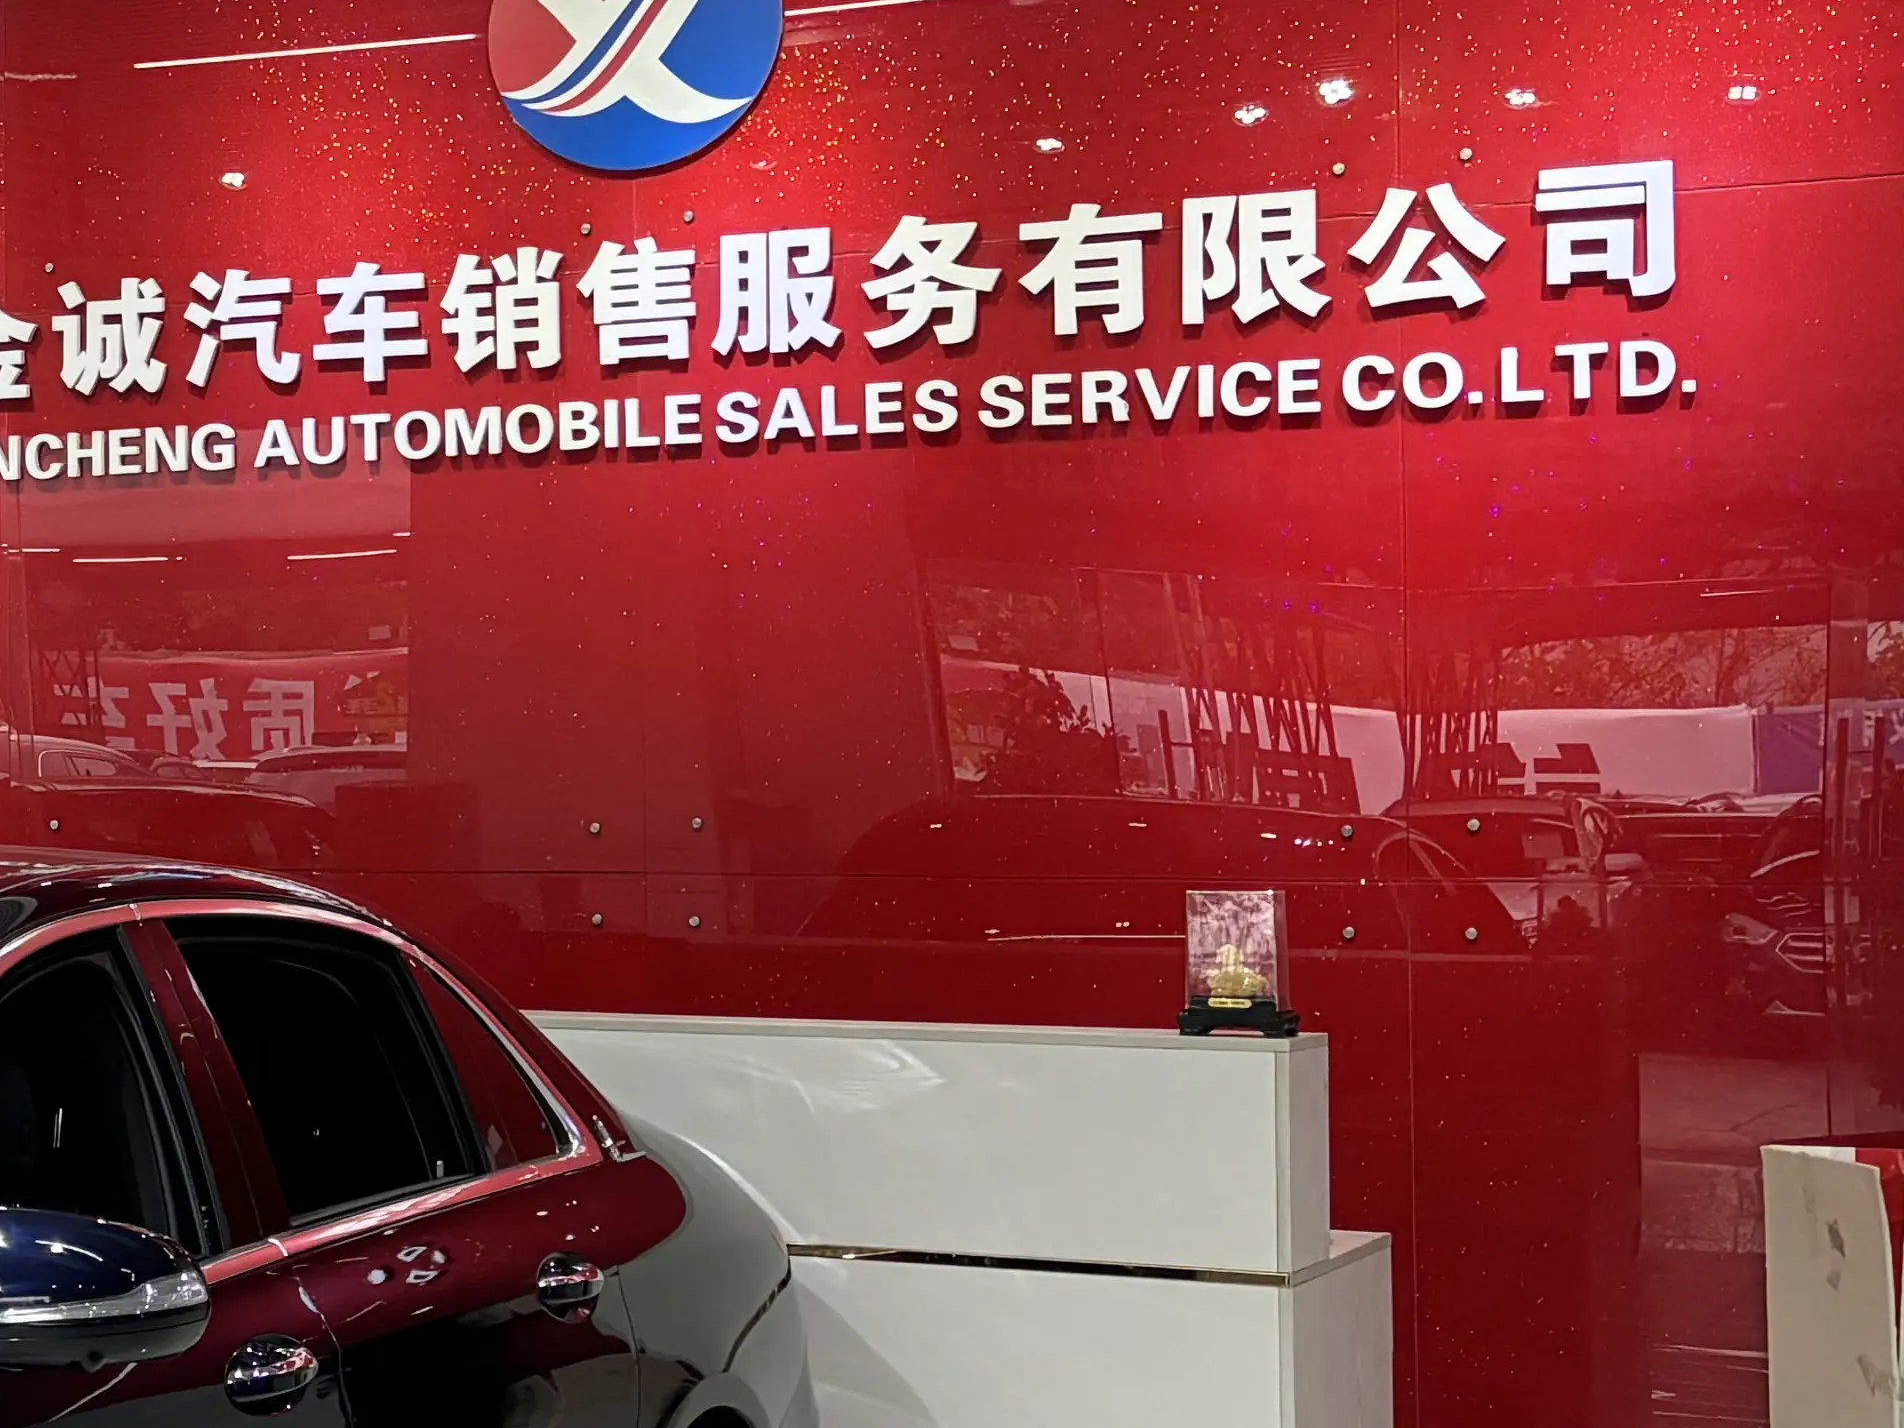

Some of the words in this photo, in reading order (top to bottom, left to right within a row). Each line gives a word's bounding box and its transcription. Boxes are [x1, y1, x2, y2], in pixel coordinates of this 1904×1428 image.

[252, 392, 704, 469] AUTOMOBILE
[713, 378, 960, 446] SALES
[977, 356, 1323, 429] SERVICE
